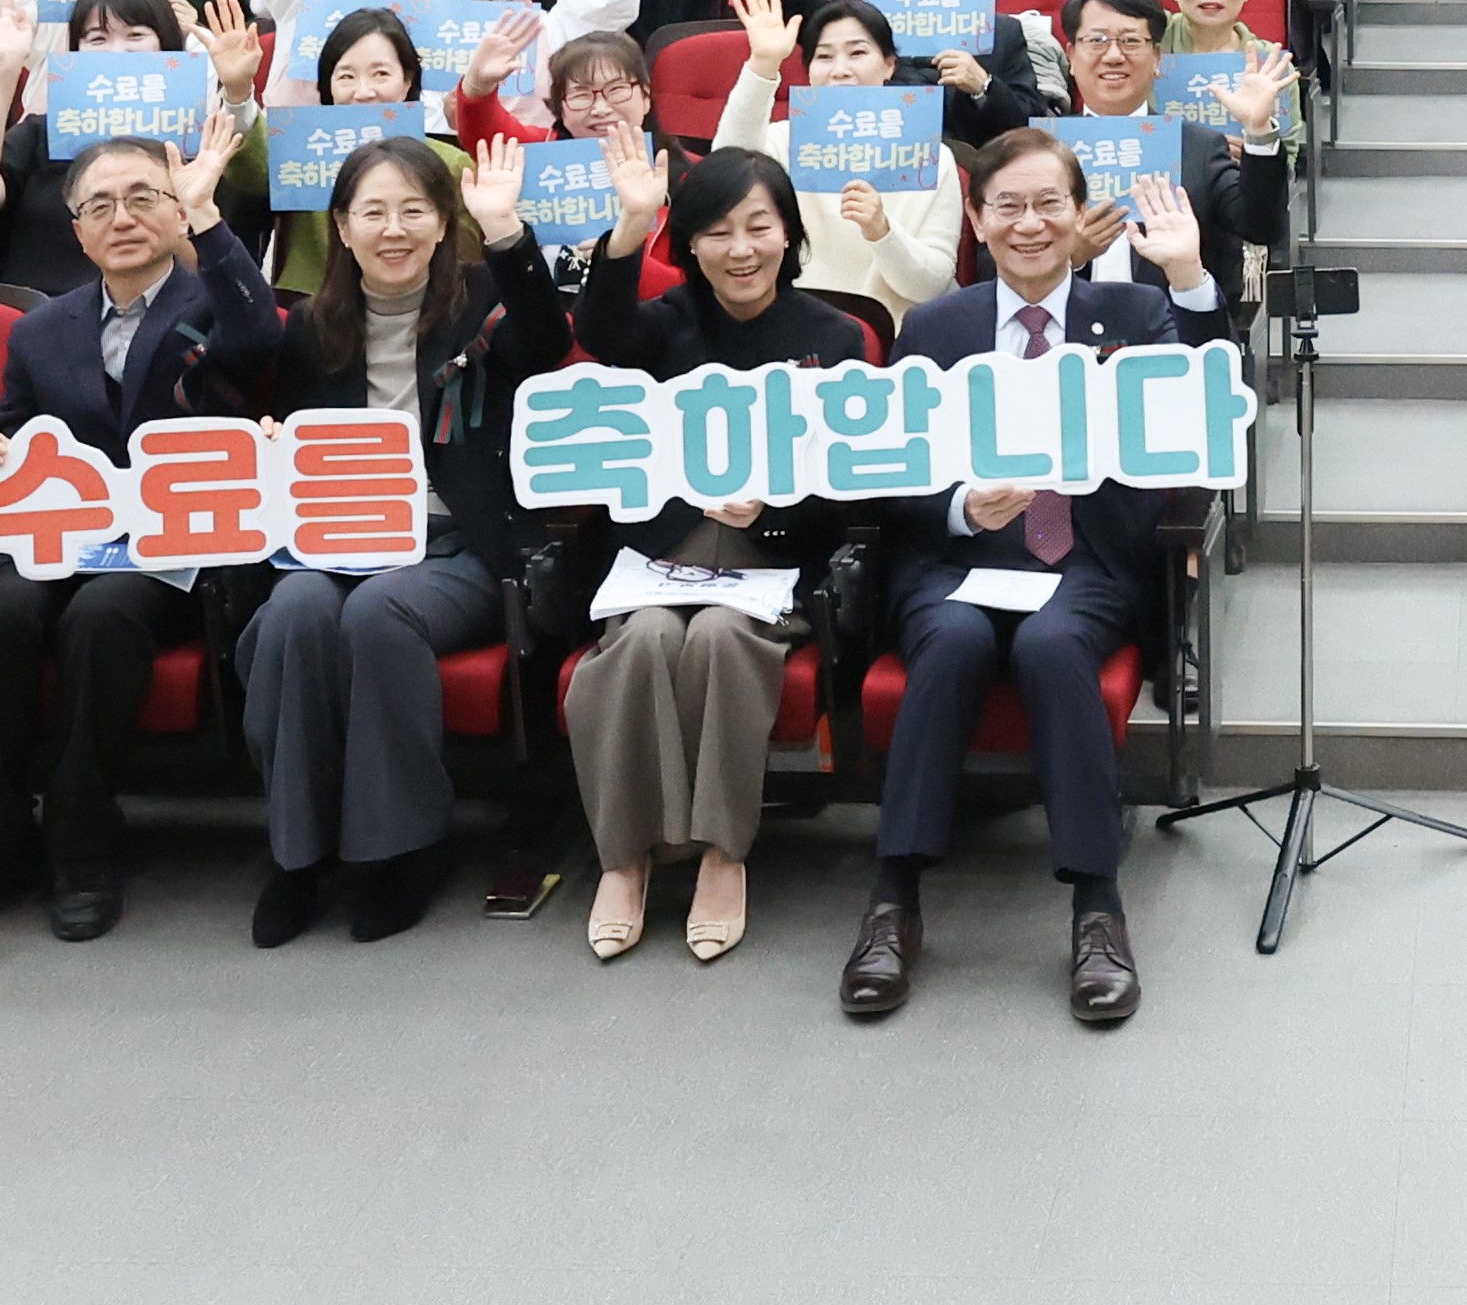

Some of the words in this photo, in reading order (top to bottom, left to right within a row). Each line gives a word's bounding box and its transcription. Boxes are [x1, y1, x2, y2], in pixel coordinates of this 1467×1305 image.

[86, 74, 166, 102] 수료를
[56, 107, 194, 137] 축하합니다!
[827, 109, 903, 139] 수료를
[1164, 99, 1280, 126] 축하합!
[797, 141, 930, 173] 축하합니다!
[538, 161, 612, 193] 수료를
[516, 193, 620, 225] 축하합니
[523, 346, 1249, 509] 축하합니다
